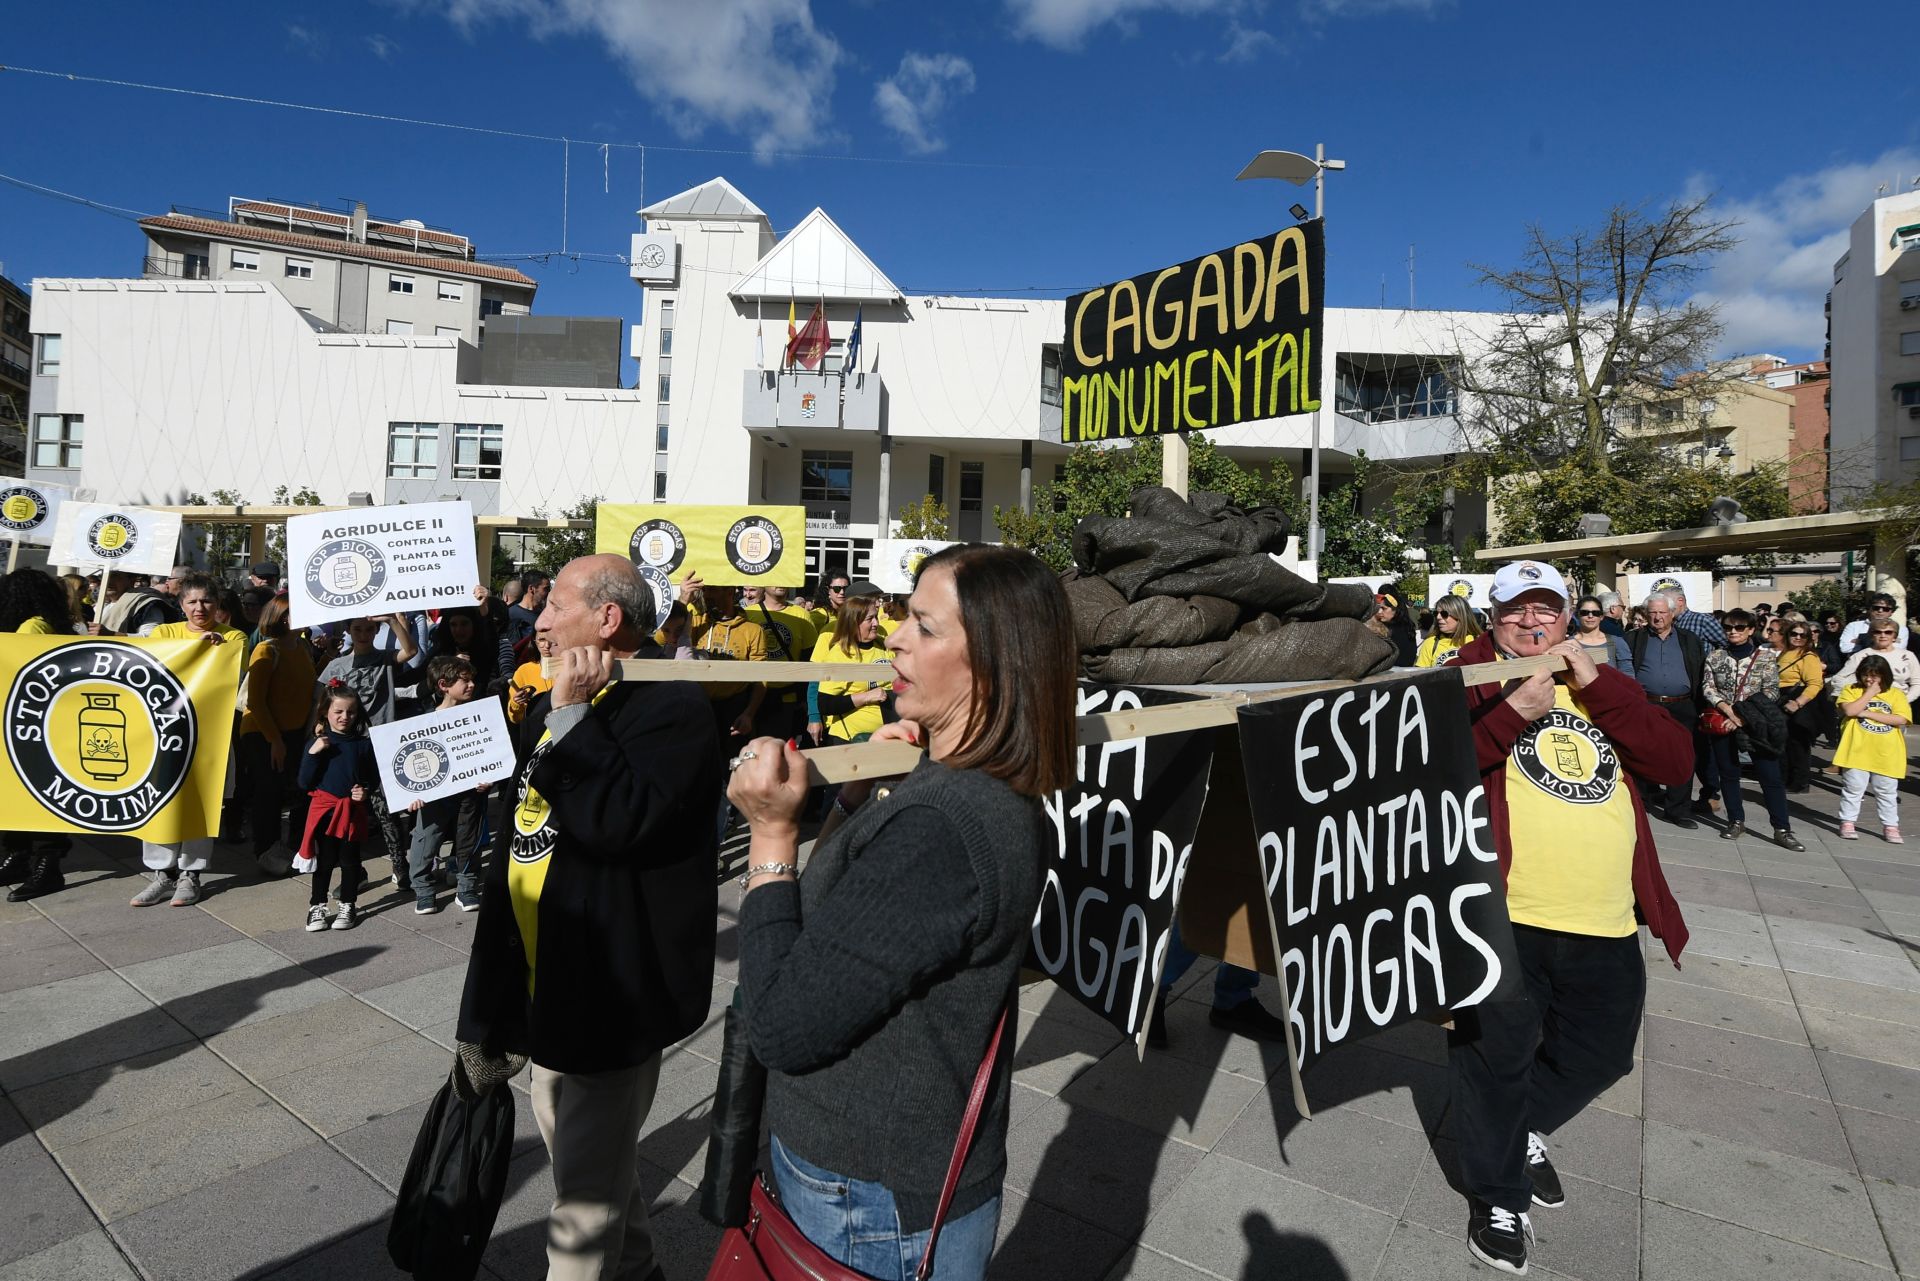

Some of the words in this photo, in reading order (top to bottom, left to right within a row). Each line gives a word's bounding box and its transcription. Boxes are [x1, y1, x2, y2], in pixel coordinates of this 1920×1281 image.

[1073, 227, 1309, 367] CAGADA
[1063, 328, 1321, 442] MONUMENTAL
[321, 519, 426, 540] AGRIDULCE
[432, 518, 443, 529] II
[632, 525, 648, 547] STOP
[728, 521, 746, 543] STOP
[821, 522, 828, 530] DE
[829, 522, 848, 530] SEGURA
[387, 537, 434, 548] CONTRA
[438, 536, 452, 544] LA
[307, 549, 328, 581] STOP
[393, 550, 438, 561] PLANTA
[442, 549, 456, 557] DE
[735, 558, 770, 573] MOLINA
[397, 562, 441, 574] BIOGAS
[318, 584, 379, 606] MOLINA
[385, 585, 426, 602] AQUÍ
[432, 585, 465, 597] NO!!
[16, 663, 60, 742] STOP
[90, 652, 187, 752] BIOGÁS
[400, 717, 470, 744] AGRIDULCE
[473, 714, 482, 723] II
[446, 730, 477, 743] CONTRA
[480, 727, 489, 735] LA
[451, 739, 481, 753] PLANTA
[483, 735, 493, 743] DE
[456, 748, 485, 761] BIOGAS
[1294, 685, 1428, 804] ESTA
[395, 750, 407, 775] STOP
[481, 761, 503, 774] NO!!
[406, 771, 446, 791] MOLINA
[43, 775, 161, 822] MOLINA
[512, 825, 559, 856] OLINA
[1259, 788, 1429, 927] PLANTA
[1441, 785, 1498, 866] DE
[1281, 882, 1502, 1073] BIOGAS
